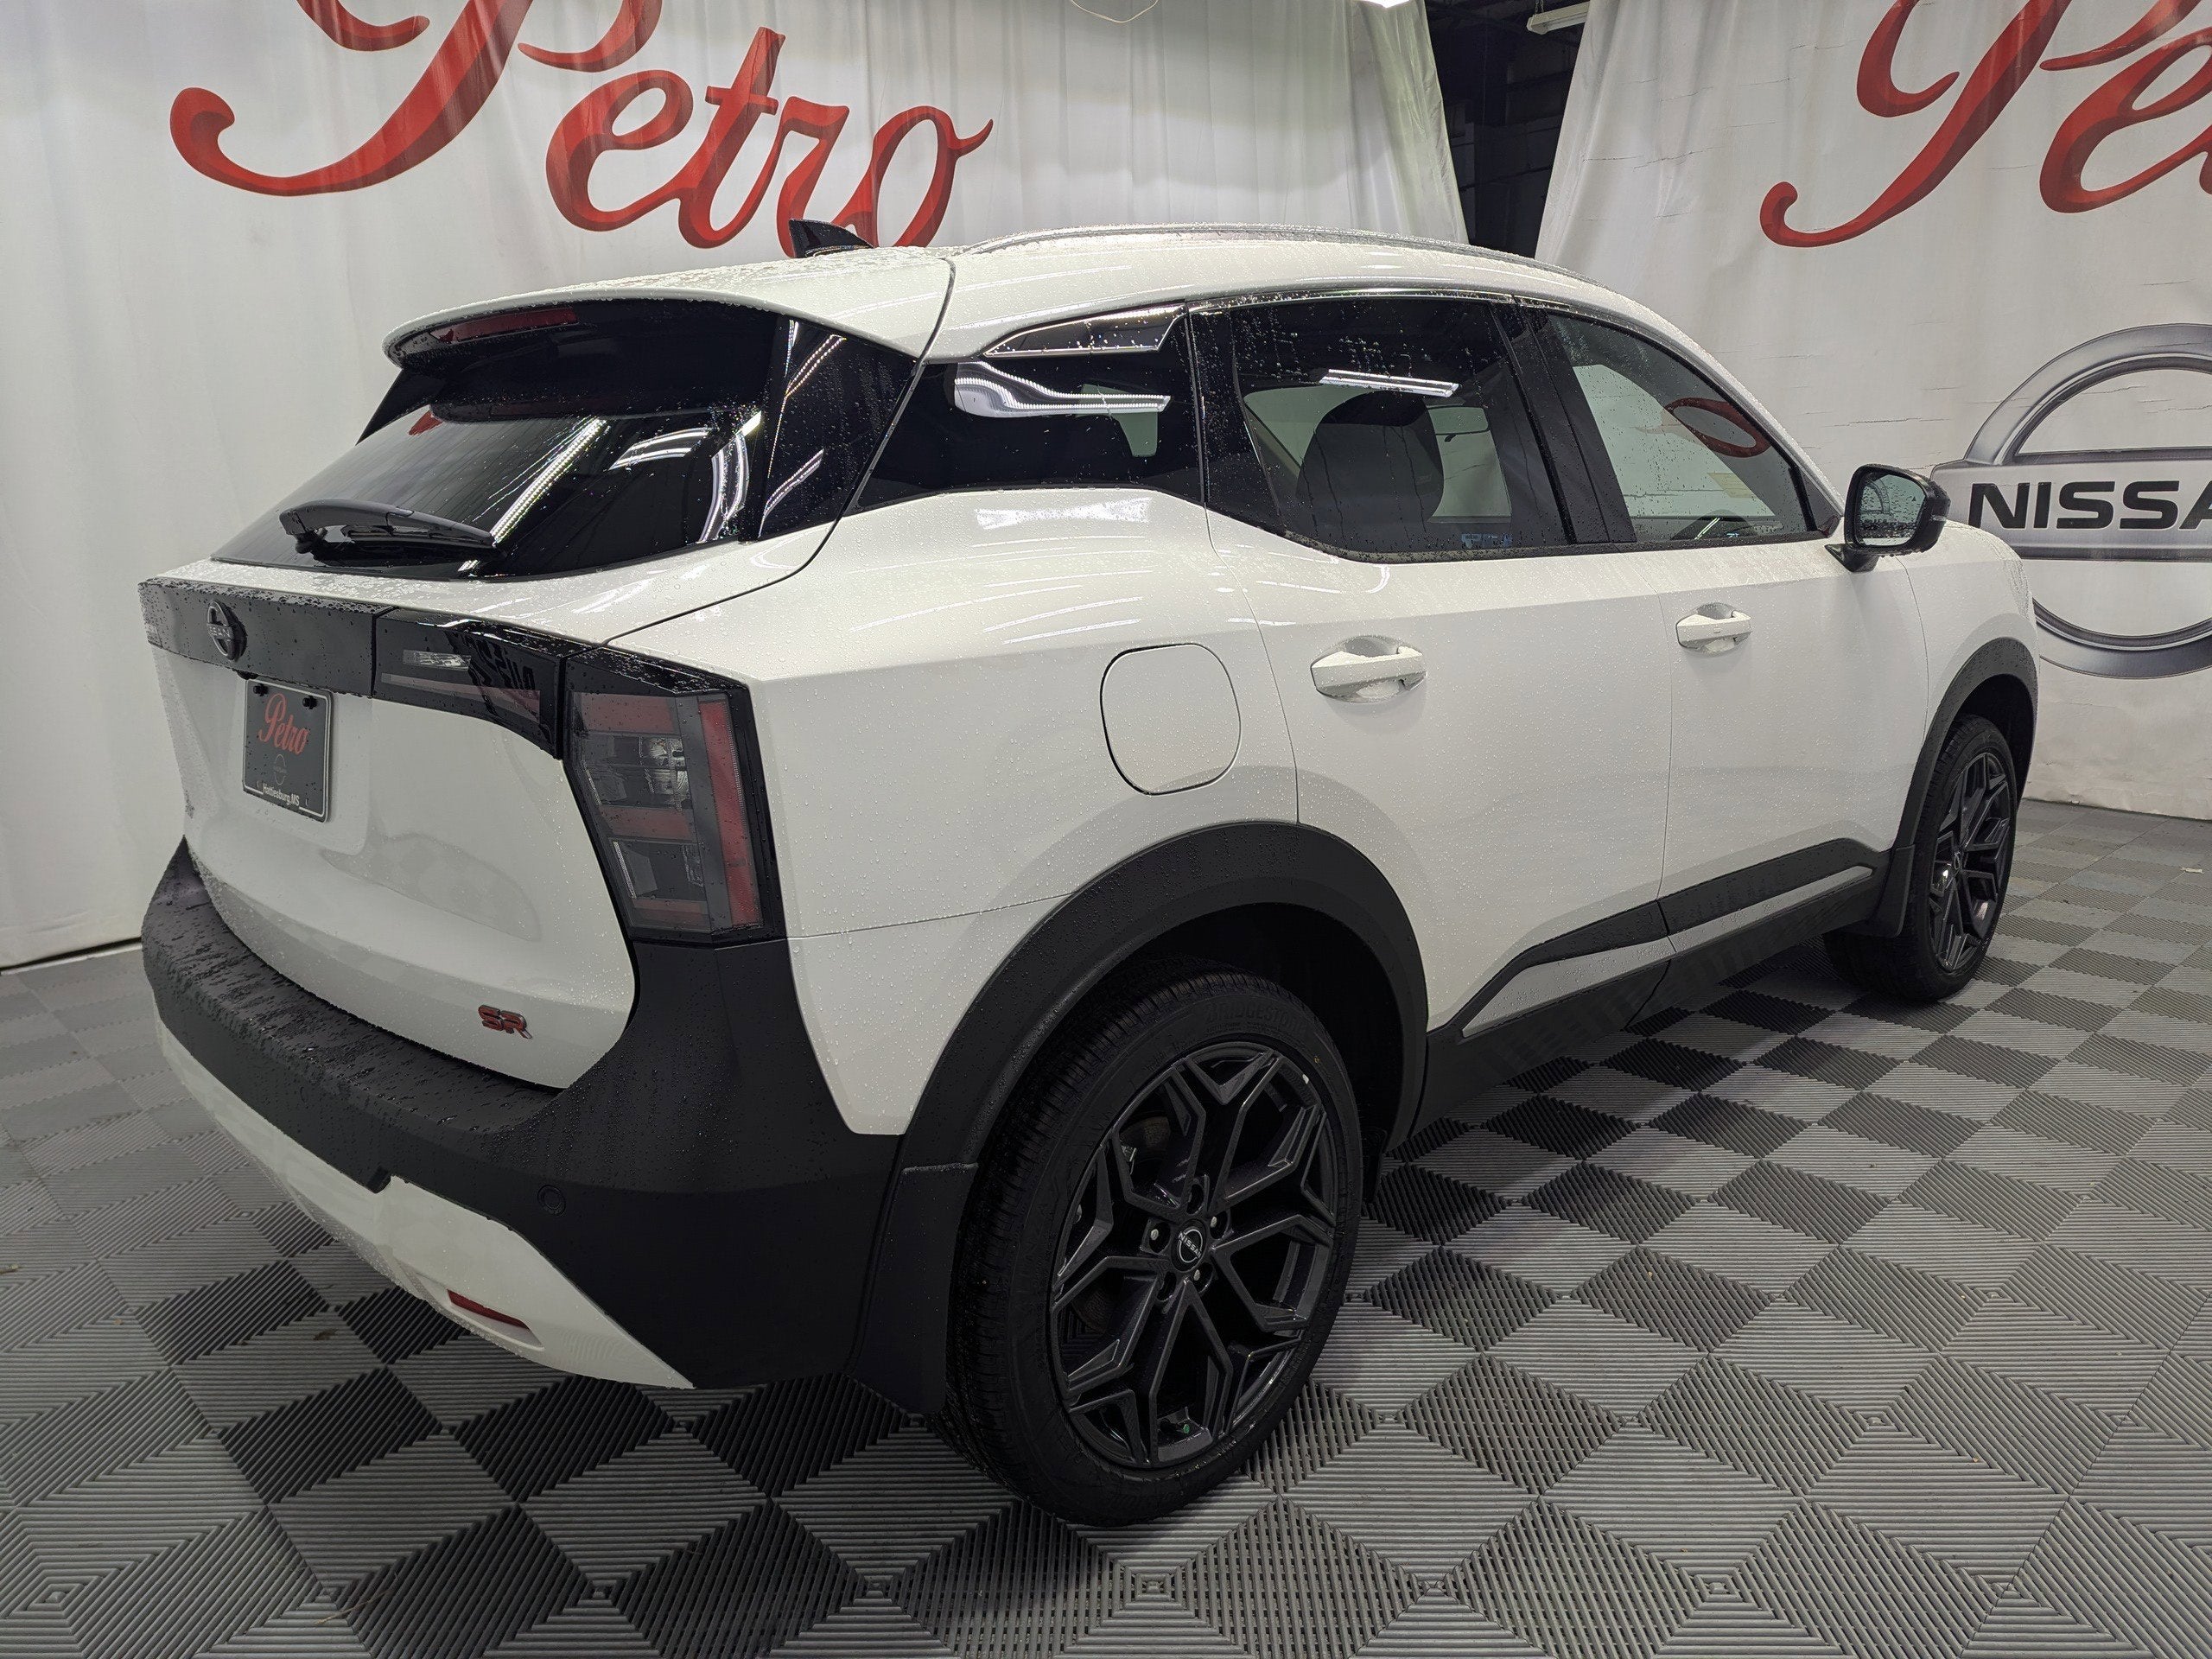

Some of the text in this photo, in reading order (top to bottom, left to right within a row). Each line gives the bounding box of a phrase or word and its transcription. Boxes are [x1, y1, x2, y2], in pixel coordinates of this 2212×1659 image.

[258, 693, 310, 755] Petro
[478, 1005, 532, 1039] SR
[1178, 1231, 1202, 1259] NISSAN
